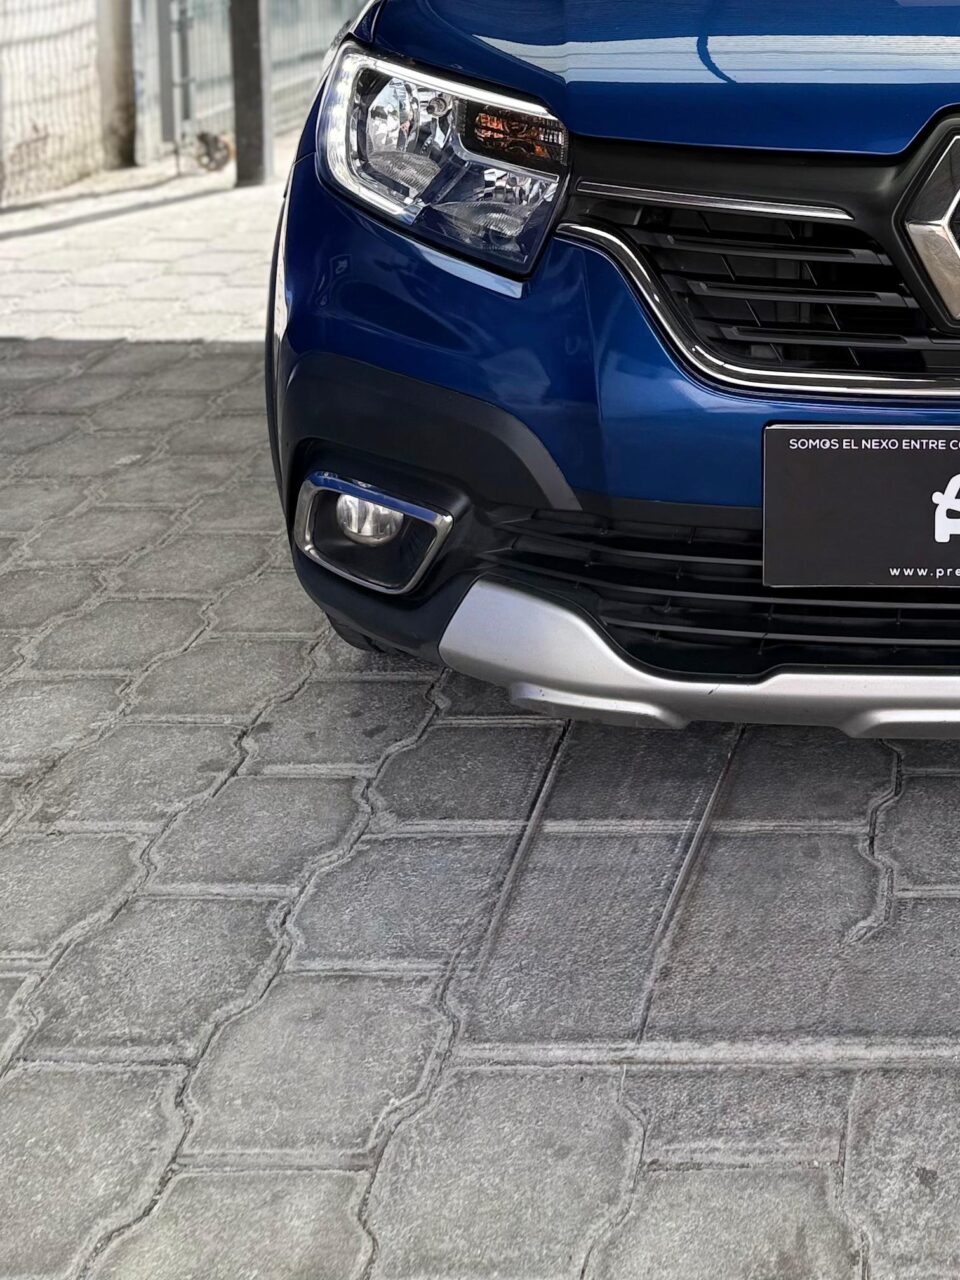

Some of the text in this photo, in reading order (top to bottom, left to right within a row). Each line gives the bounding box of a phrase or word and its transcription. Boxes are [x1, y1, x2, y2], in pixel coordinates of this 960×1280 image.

[789, 438, 840, 450] SOMOS
[842, 438, 859, 450] EL
[861, 438, 899, 450] NEXO
[902, 439, 947, 451] ENTRE
